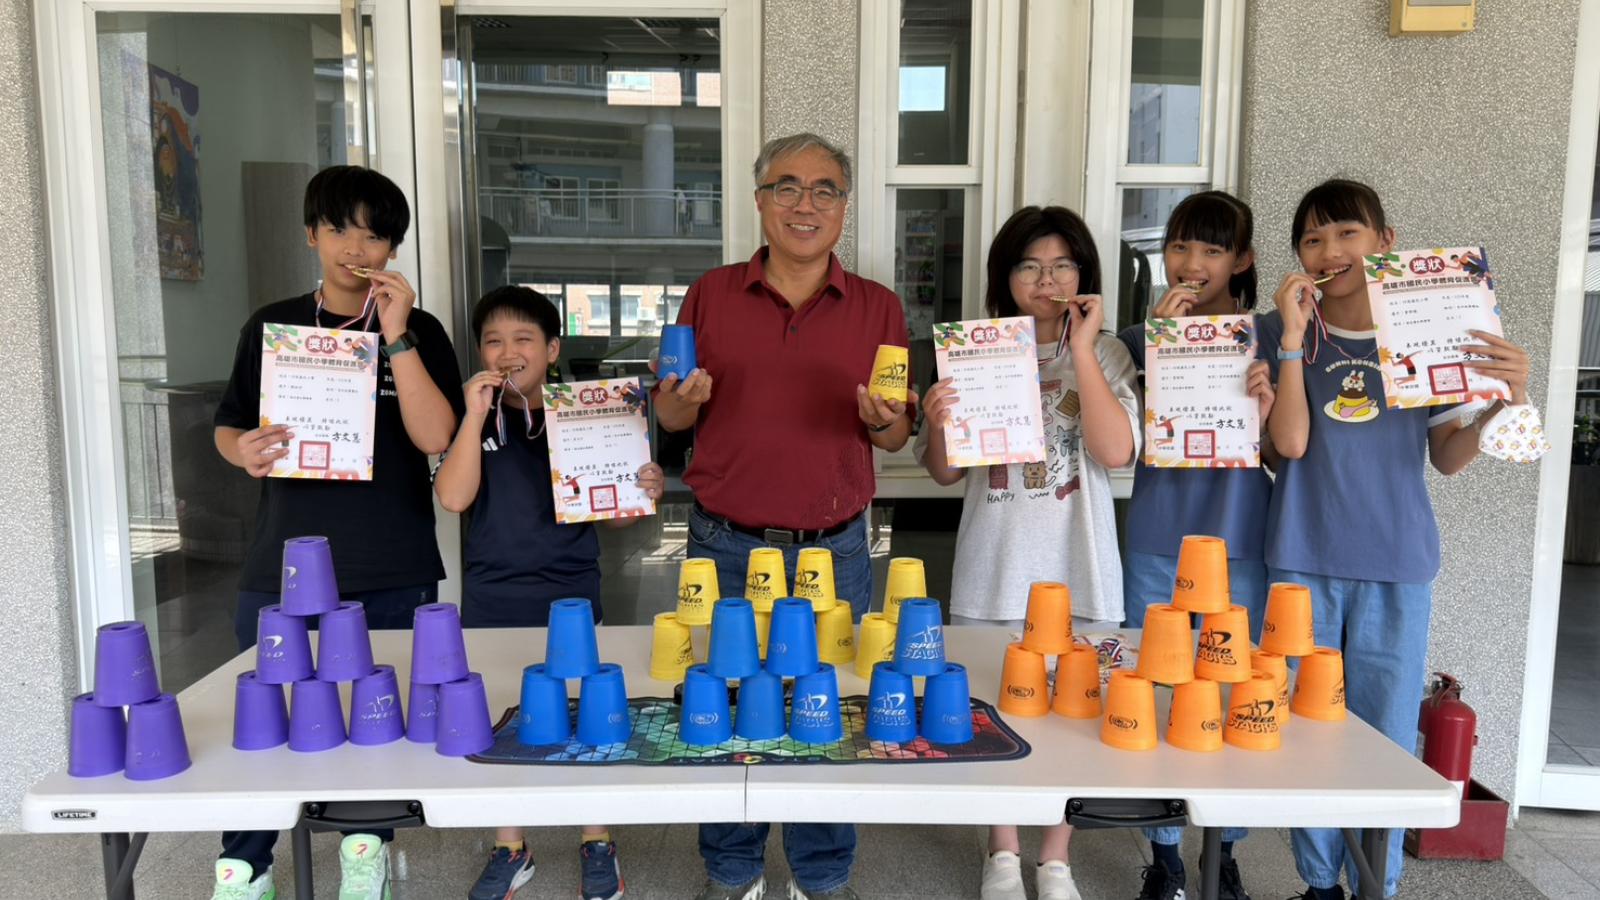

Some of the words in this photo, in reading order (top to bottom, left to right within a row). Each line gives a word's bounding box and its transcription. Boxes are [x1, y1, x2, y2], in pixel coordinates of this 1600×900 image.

[1413, 258, 1442, 272] 獎狀
[974, 328, 998, 342] 獎狀
[1187, 326, 1214, 339] 獎狀
[308, 336, 335, 350] 獎狀
[582, 389, 606, 402] 獎狀
